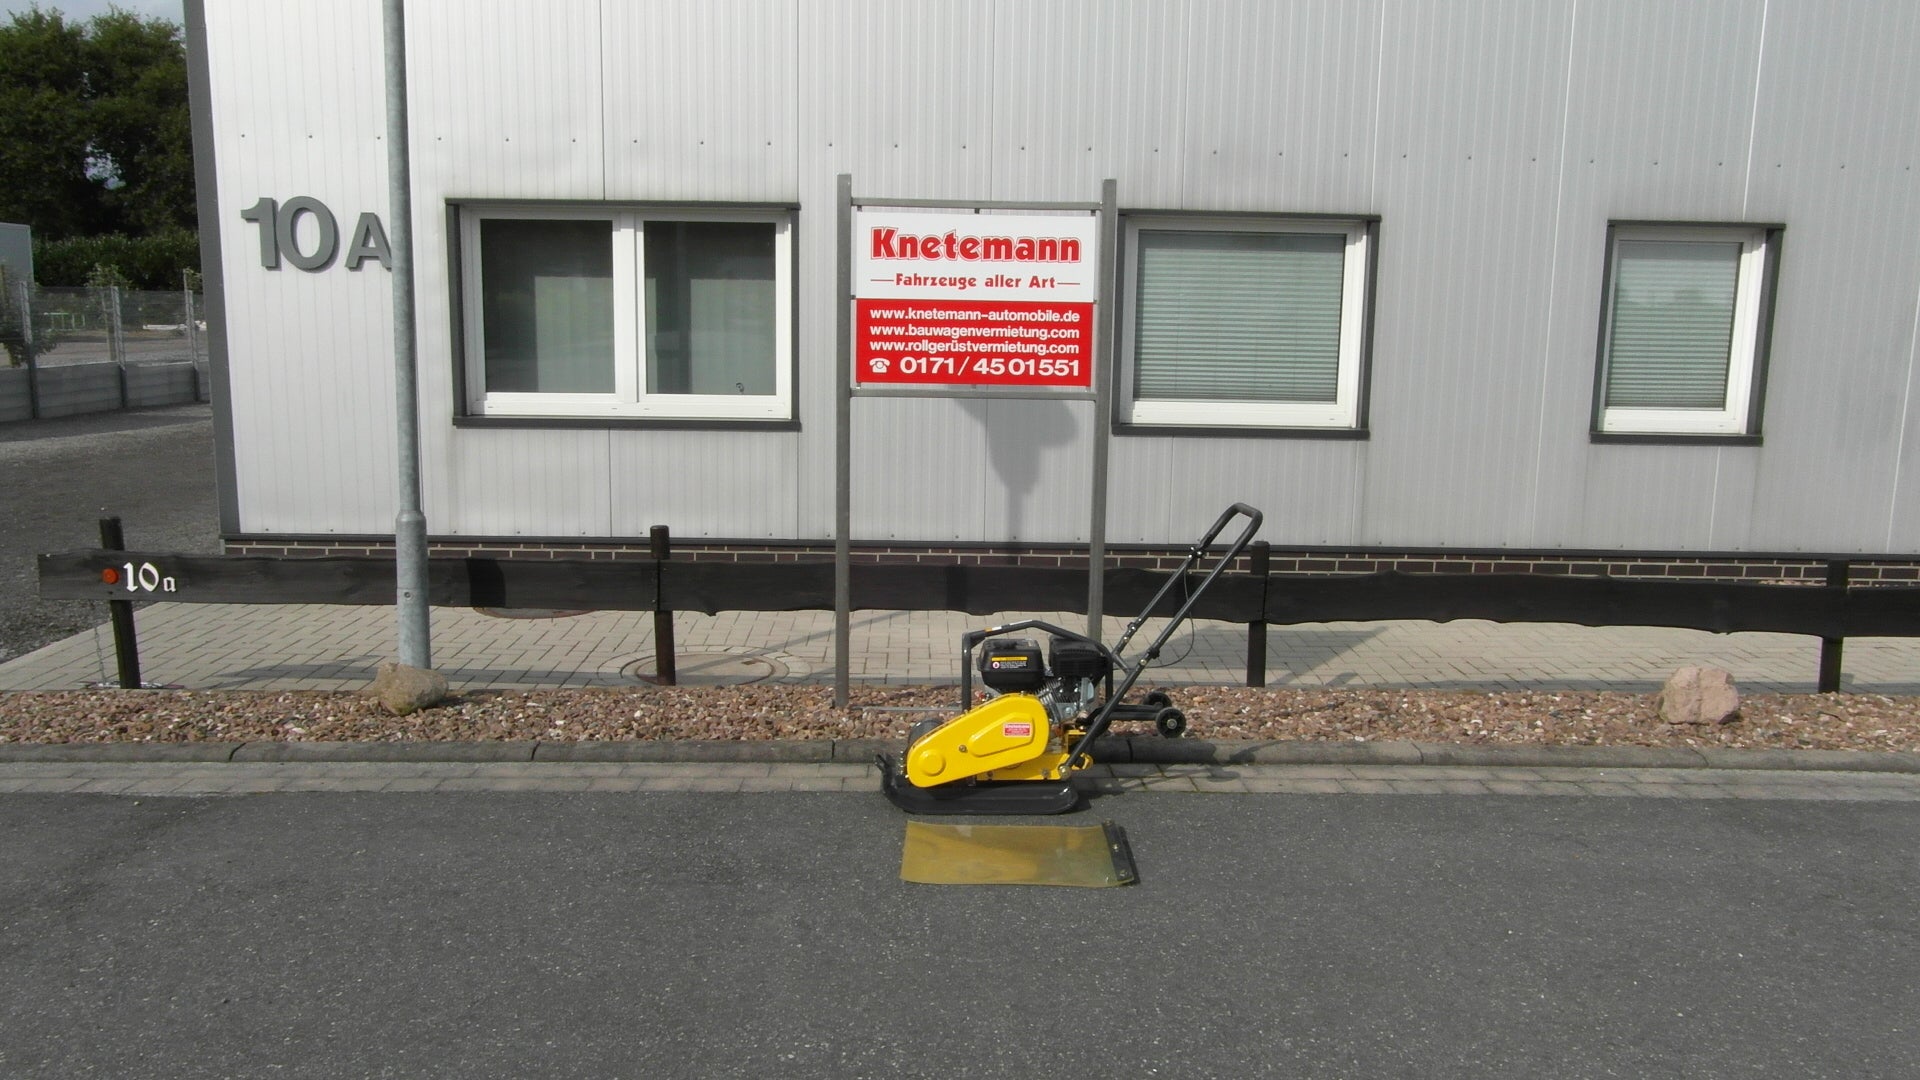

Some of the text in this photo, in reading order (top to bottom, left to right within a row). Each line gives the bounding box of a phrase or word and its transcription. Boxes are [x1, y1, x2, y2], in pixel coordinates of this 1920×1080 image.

[871, 226, 1081, 263] Knetemann
[896, 272, 1056, 290] Fahrzeuge aller Art
[870, 307, 1080, 322] www.knetemann-automobile.de
[870, 324, 1080, 340] www.bauwagenvermietung.com
[870, 339, 1079, 355] www.rollgerüstvermietung.com
